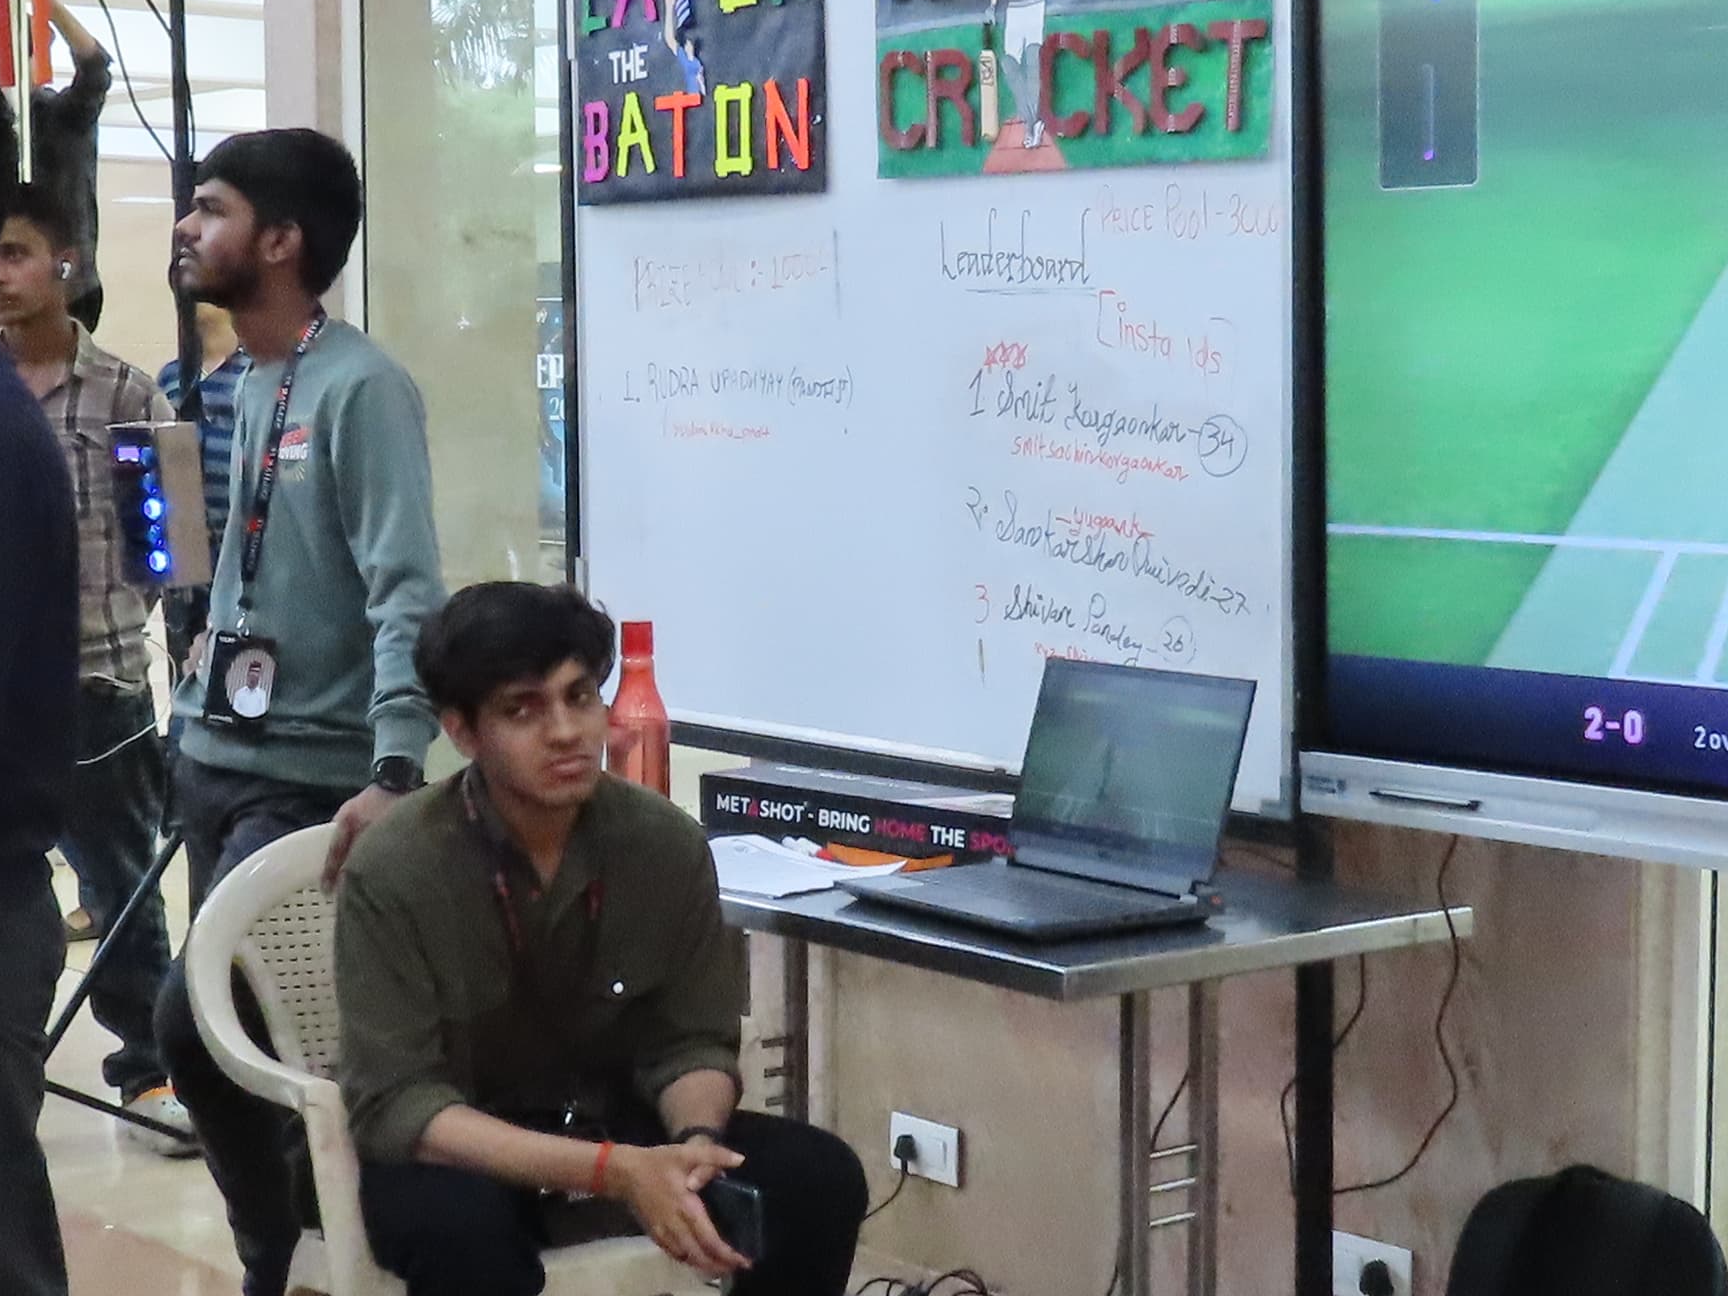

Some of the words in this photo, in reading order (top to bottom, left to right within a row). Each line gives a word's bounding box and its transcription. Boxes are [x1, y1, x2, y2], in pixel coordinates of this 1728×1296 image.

[608, 42, 650, 85] THE
[879, 19, 1269, 150] CRICKET
[583, 78, 811, 184] BATON
[940, 207, 1092, 285] Leaderboard
[647, 362, 699, 402] RUDRA
[1583, 706, 1645, 746] 2-0
[818, 808, 871, 834] BRING
[874, 817, 927, 843] HOME
[930, 824, 966, 849] THE
